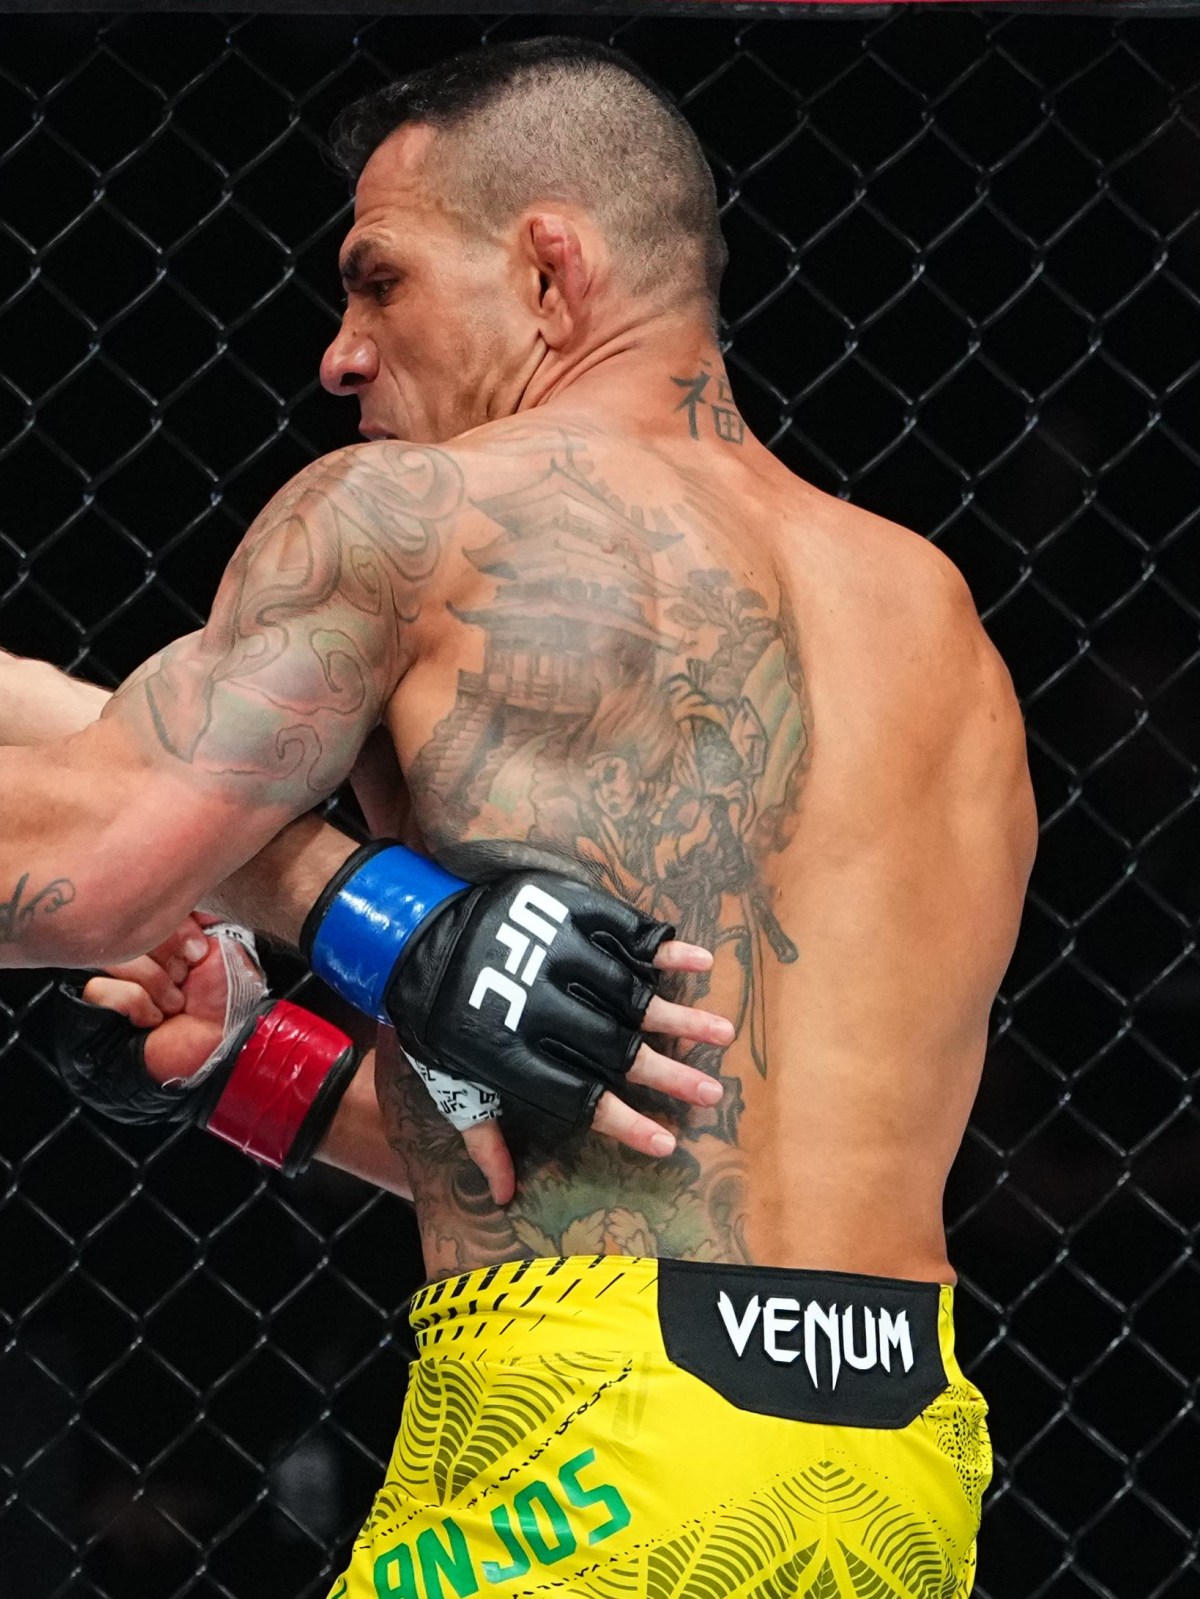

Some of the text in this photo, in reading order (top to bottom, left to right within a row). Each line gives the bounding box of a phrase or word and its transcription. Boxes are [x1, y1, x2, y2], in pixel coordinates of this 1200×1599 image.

[468, 884, 570, 1032] UFC
[716, 1290, 915, 1391] VENUM
[372, 1447, 633, 1599] ANJOS
